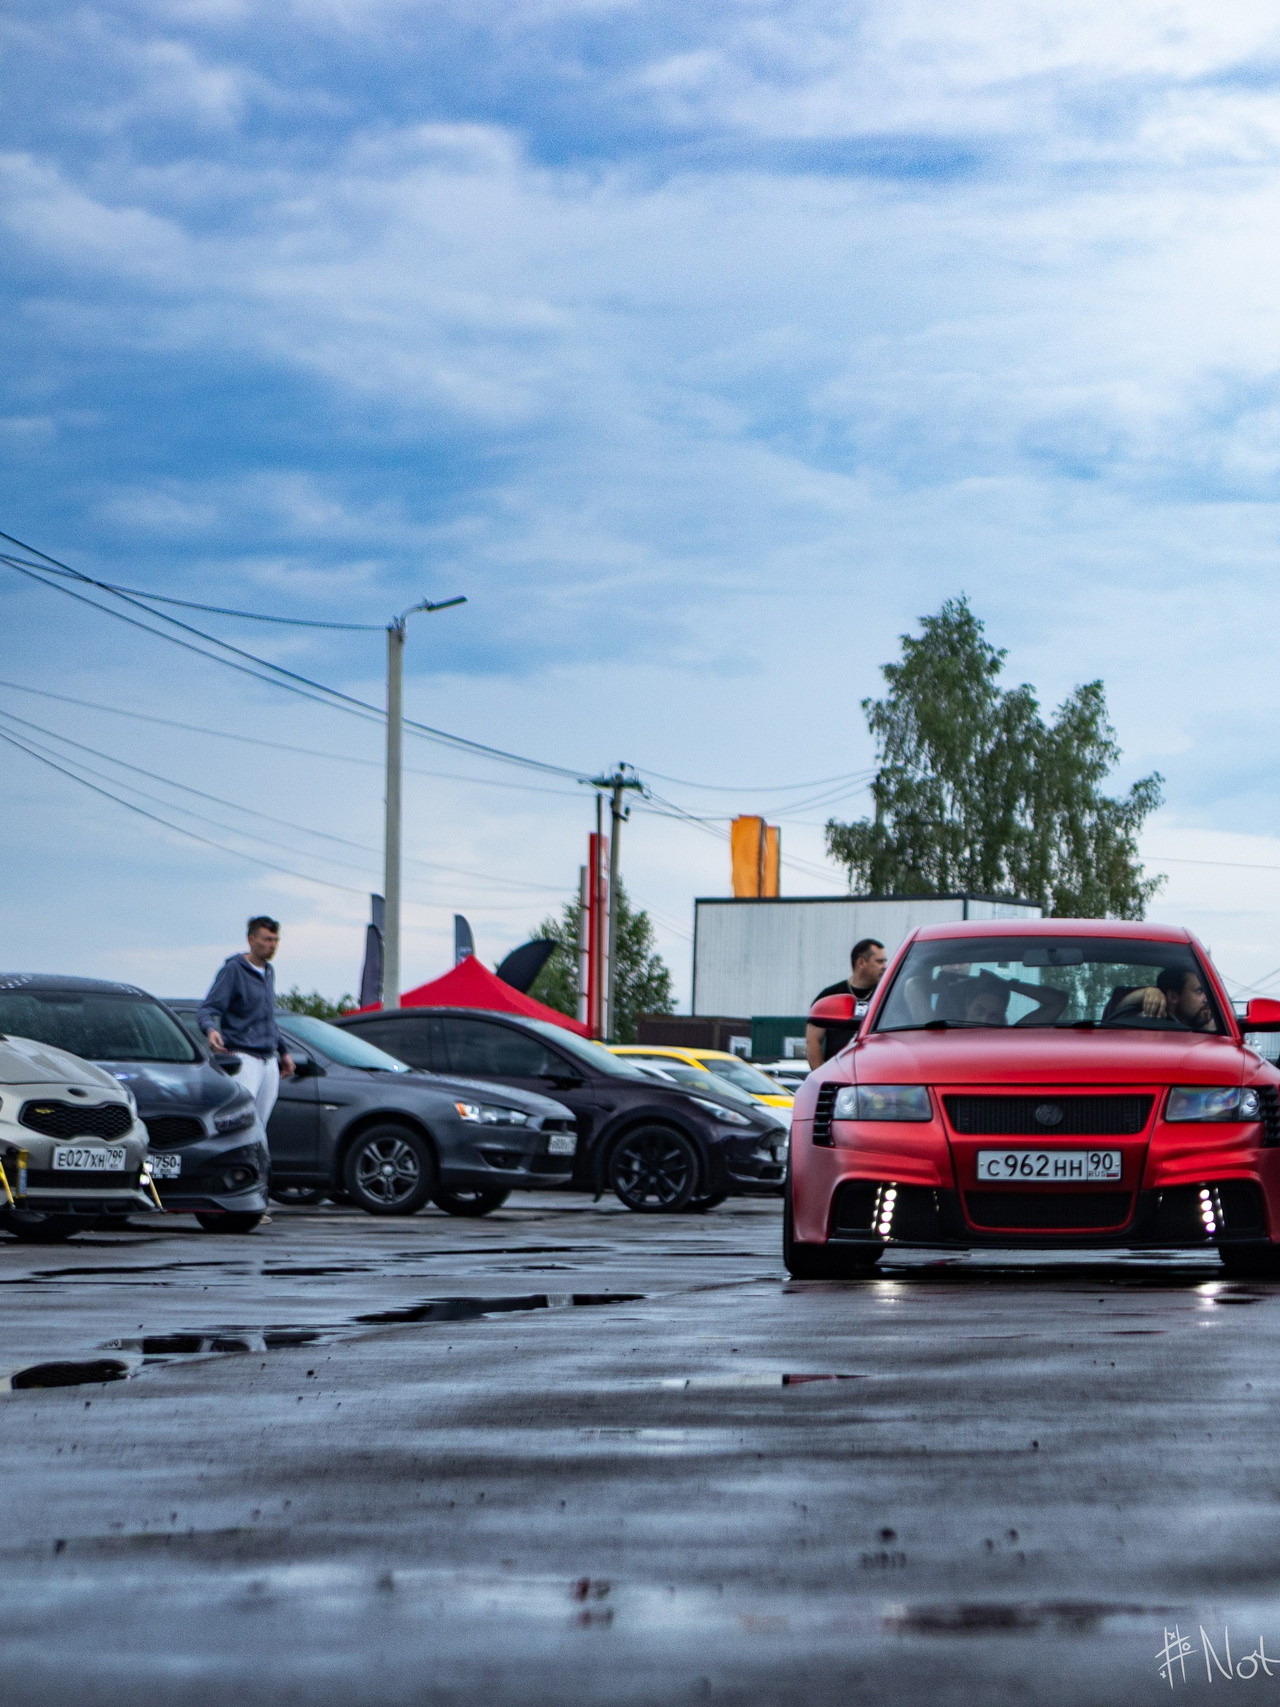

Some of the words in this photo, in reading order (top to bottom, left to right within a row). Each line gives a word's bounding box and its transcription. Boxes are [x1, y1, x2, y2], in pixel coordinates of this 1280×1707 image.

[58, 1150, 105, 1168] Е027ХН
[155, 1157, 176, 1168] 750
[987, 1154, 1082, 1177] С962НН
[1090, 1153, 1113, 1170] 90
